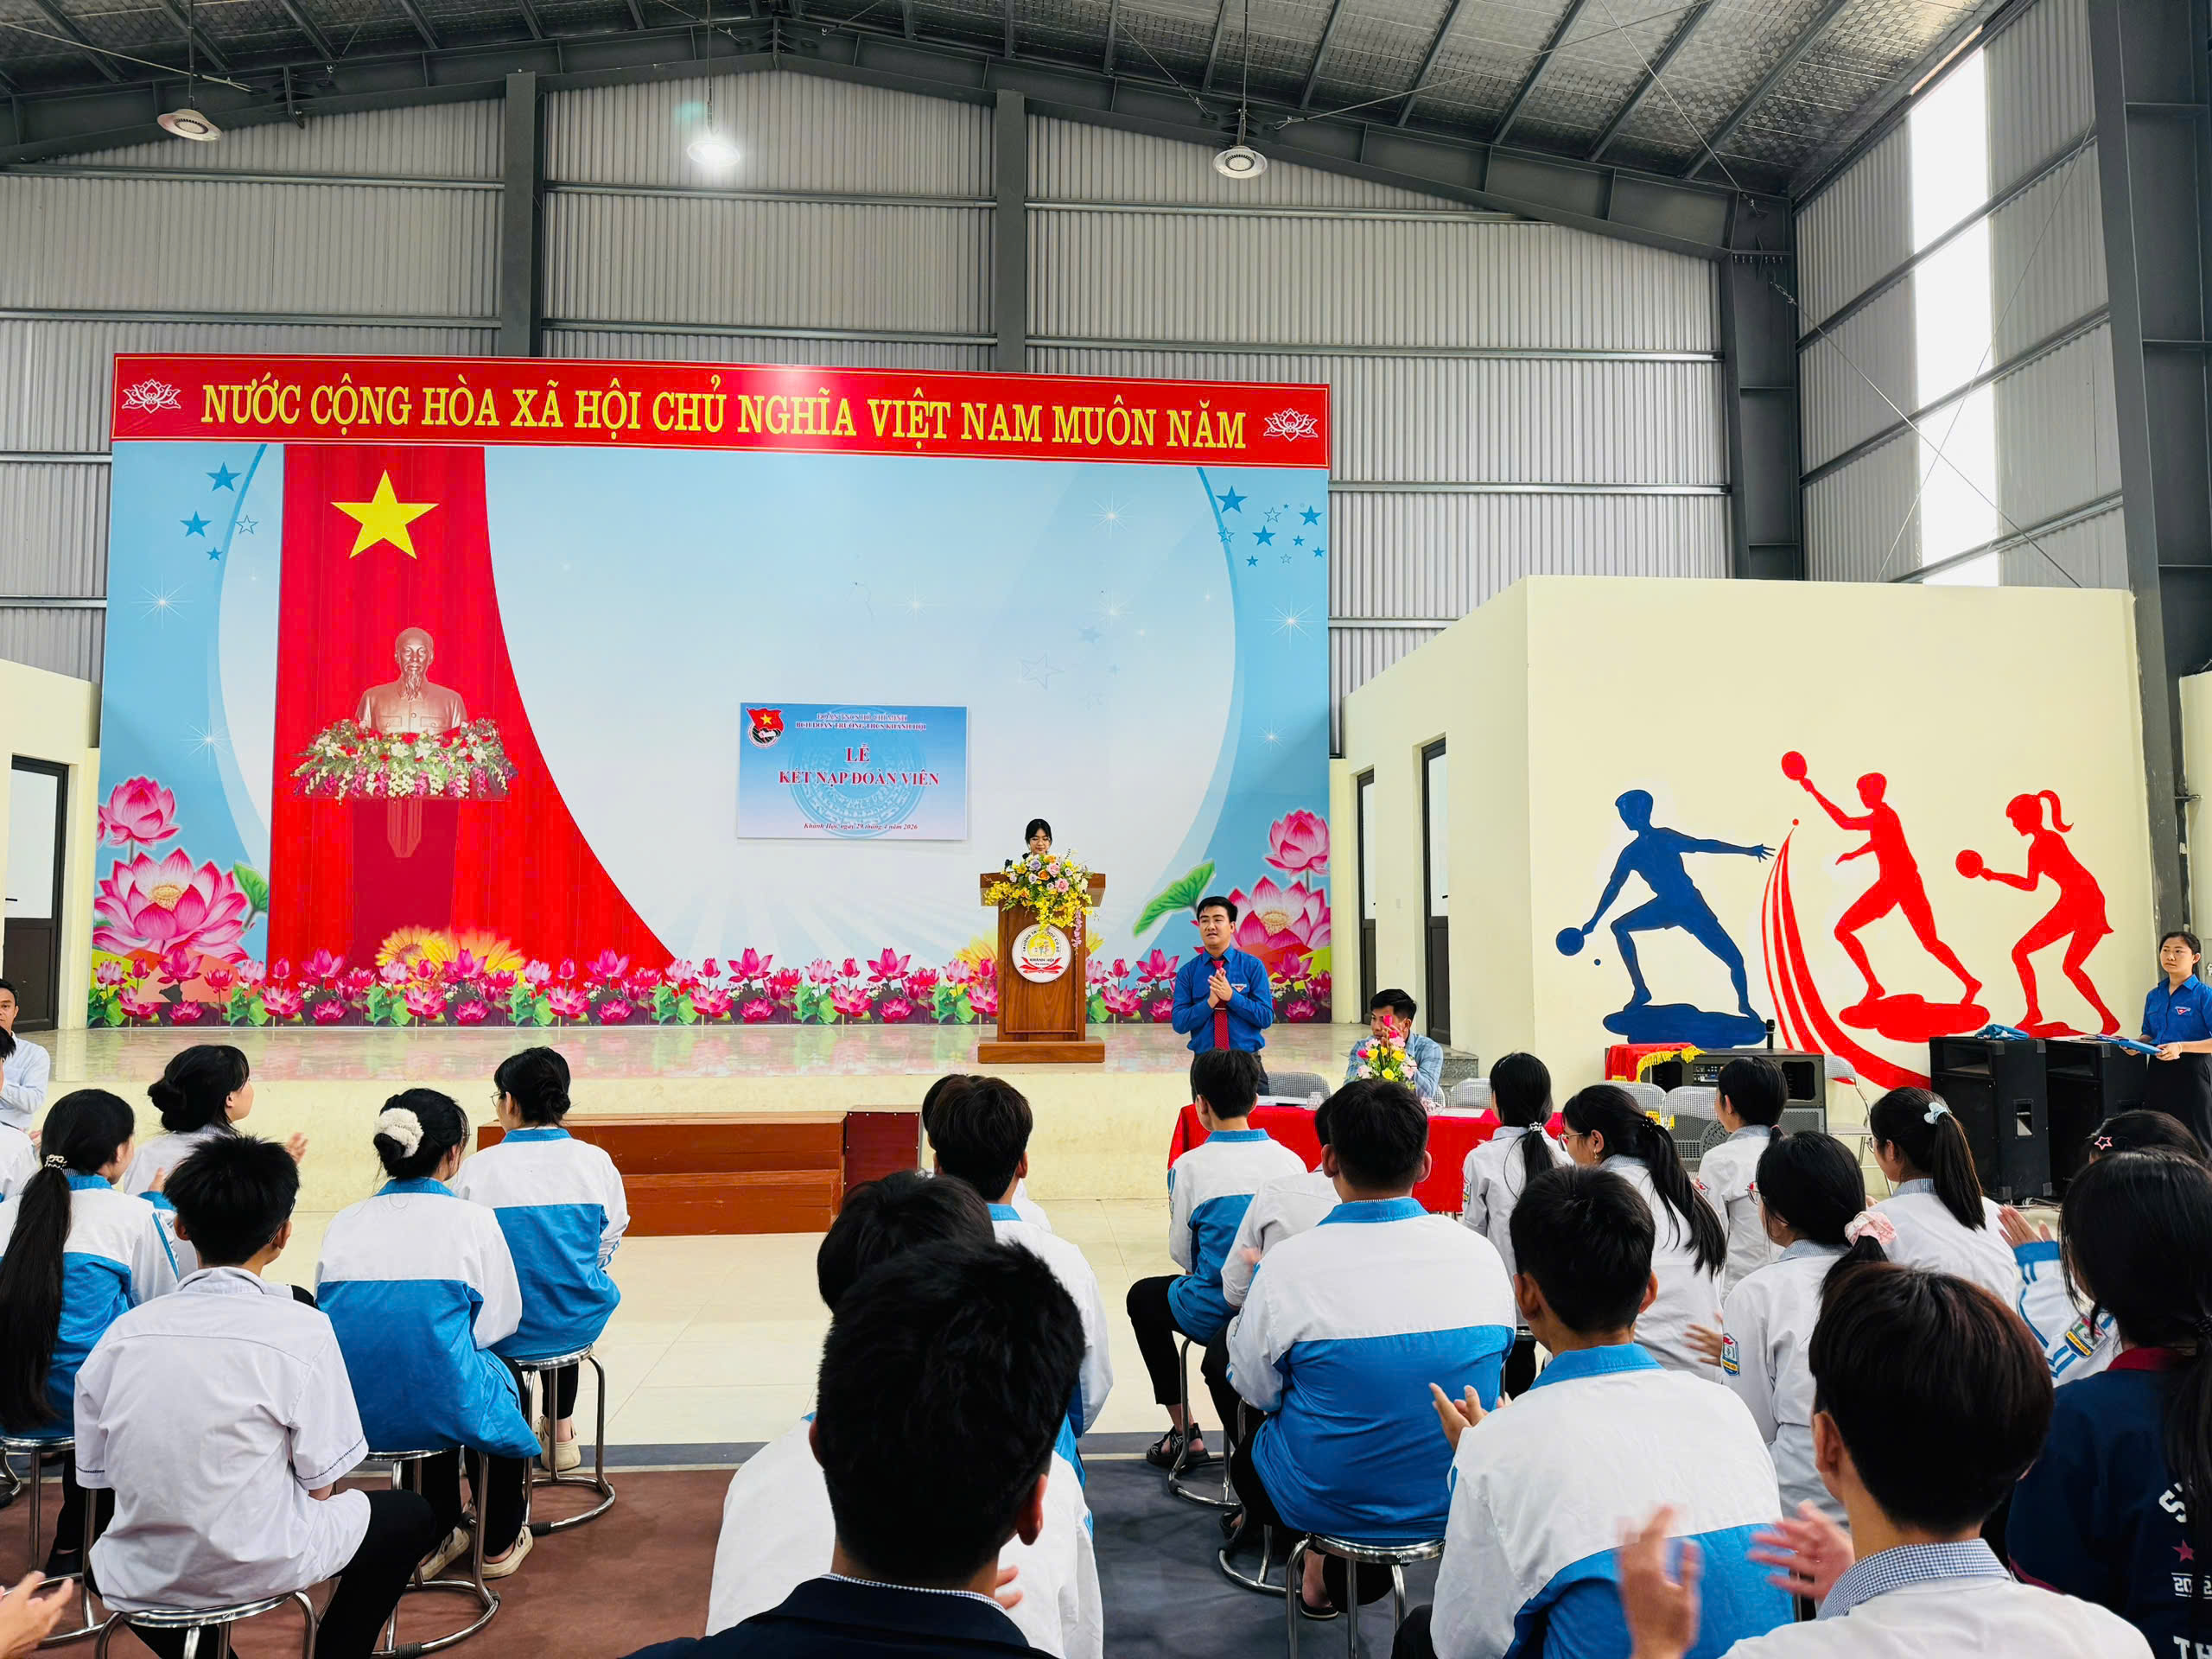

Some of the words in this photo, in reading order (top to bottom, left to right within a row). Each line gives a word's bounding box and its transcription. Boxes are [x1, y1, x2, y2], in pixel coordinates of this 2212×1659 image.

[201, 372, 301, 424] NƯỚC
[310, 372, 412, 435] CỘNG
[421, 374, 500, 427] HÒA
[510, 379, 564, 428] XÃ
[574, 378, 642, 440] HỘI
[652, 376, 727, 433] CHỦ
[737, 388, 857, 436] NGHĨA
[867, 387, 951, 449] VIỆT
[961, 403, 1043, 442] NAM
[1052, 395, 1157, 446] MUÔN
[1166, 400, 1246, 448] NĂM
[846, 743, 871, 763] LỄ
[779, 767, 812, 785] KẾT
[817, 772, 849, 787] NẠP
[851, 768, 897, 785] ĐOÀN
[901, 768, 940, 786] VIÊN
